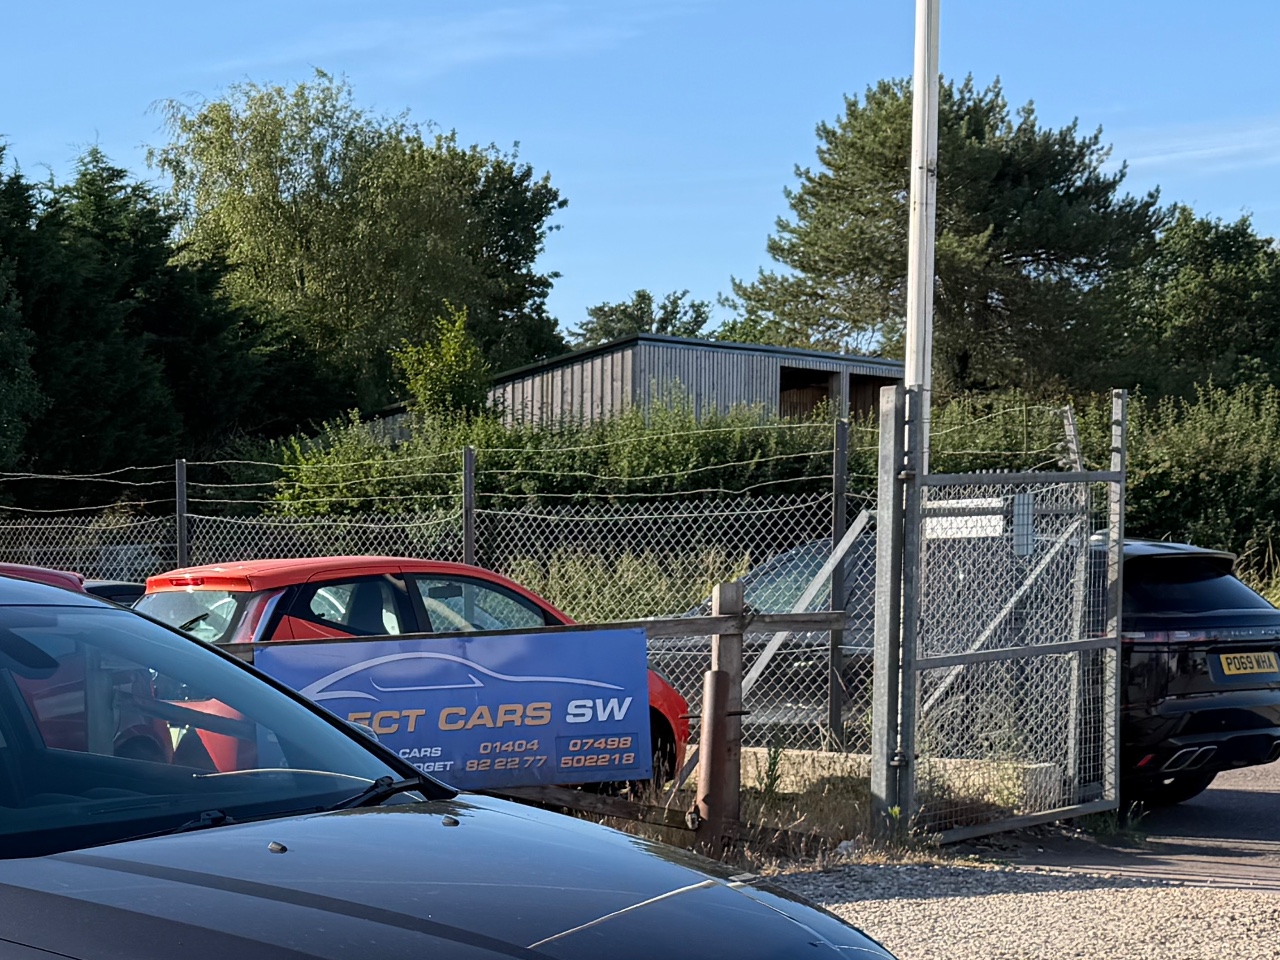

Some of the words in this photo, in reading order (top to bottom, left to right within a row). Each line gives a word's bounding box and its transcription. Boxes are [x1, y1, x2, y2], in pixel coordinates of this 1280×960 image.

[438, 701, 552, 731] CARS
[565, 696, 633, 723] SW
[479, 740, 539, 754] 01404
[568, 736, 632, 751] 07498
[399, 747, 442, 759] CARS
[560, 753, 635, 768] 502218
